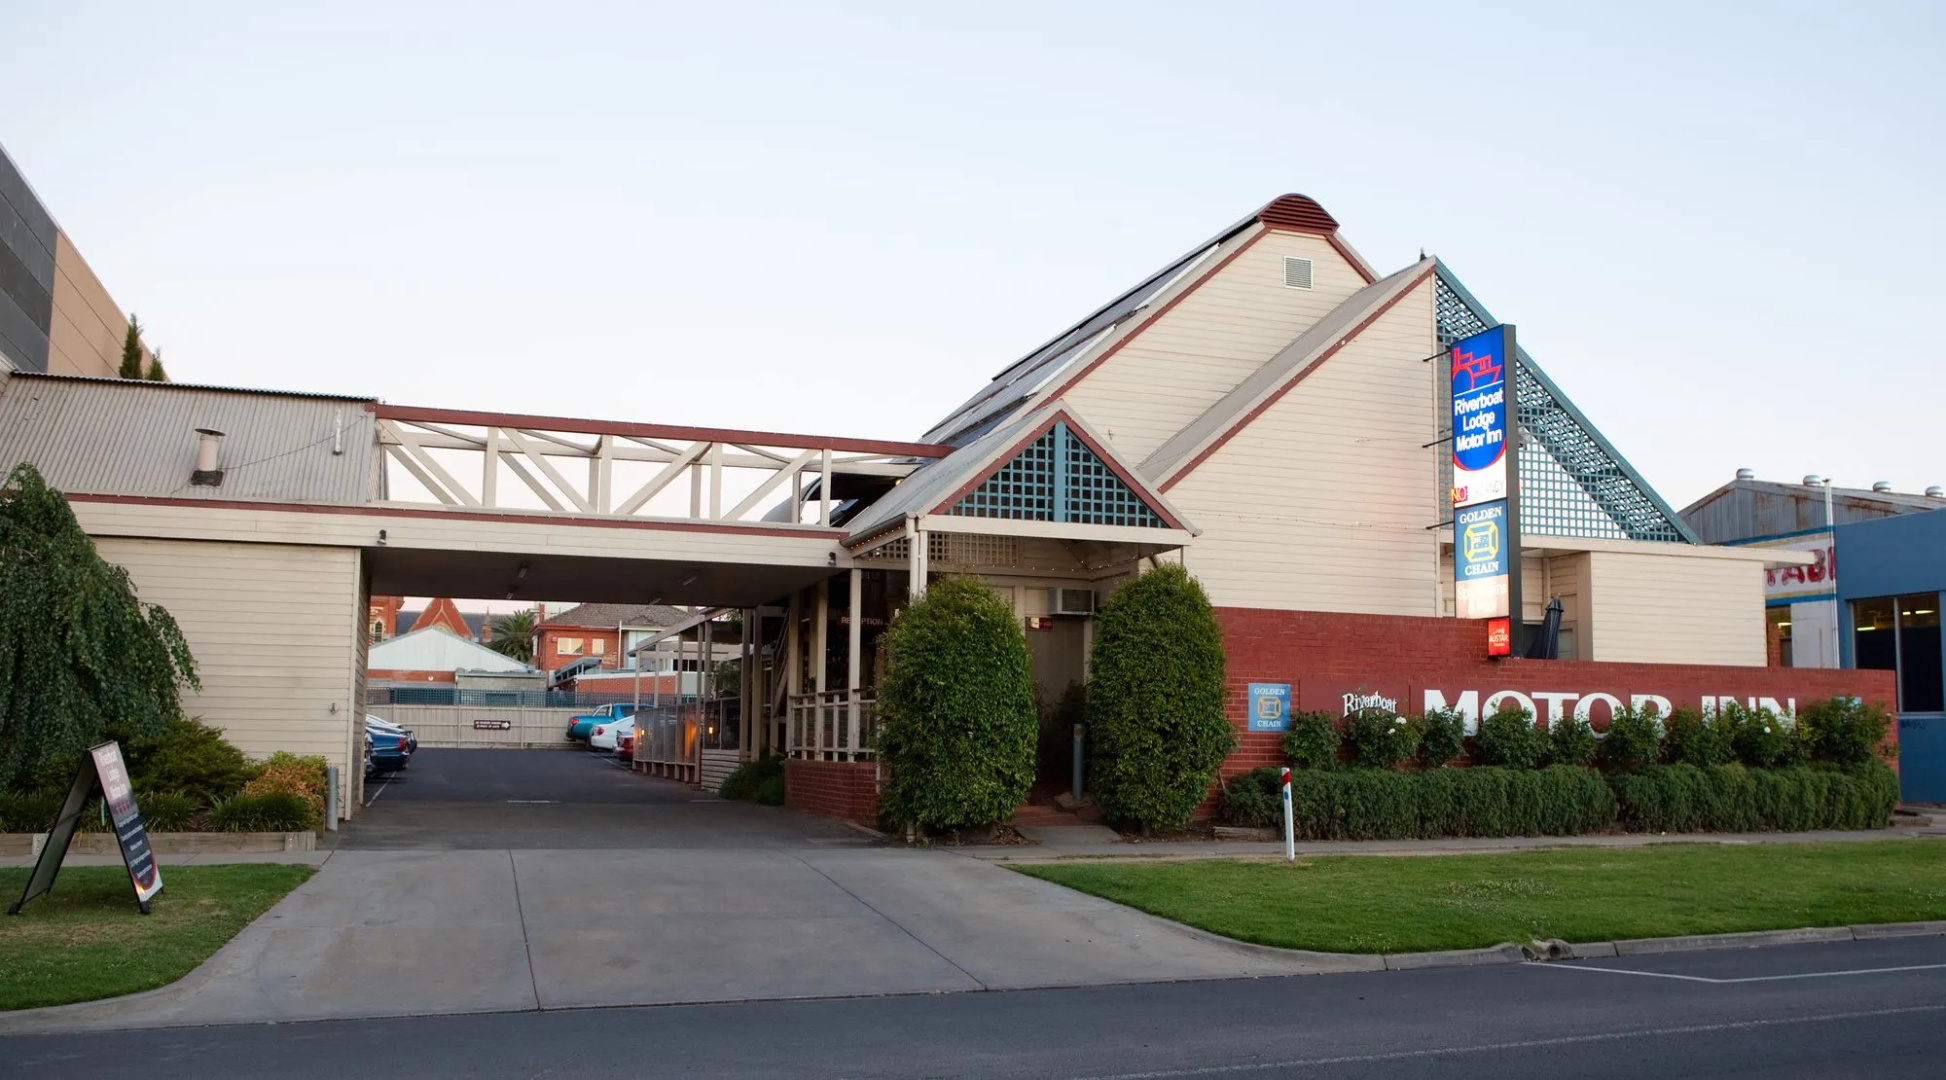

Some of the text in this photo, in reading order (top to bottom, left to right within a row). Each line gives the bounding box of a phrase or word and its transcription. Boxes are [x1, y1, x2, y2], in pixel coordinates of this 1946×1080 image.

[1455, 387, 1503, 416] Riverboat
[1463, 410, 1496, 431] Lodge
[1456, 428, 1502, 452] Motor Inn
[1450, 487, 1467, 502] NO
[1460, 506, 1502, 524] GOLDEN
[1465, 561, 1499, 575] CHAIN
[841, 616, 883, 626] REPTION
[1254, 687, 1286, 696] GOLDEN
[1342, 690, 1397, 718] Riverboat
[1424, 689, 1797, 740] MOTOR INN
[1257, 720, 1282, 728] CHAIN
